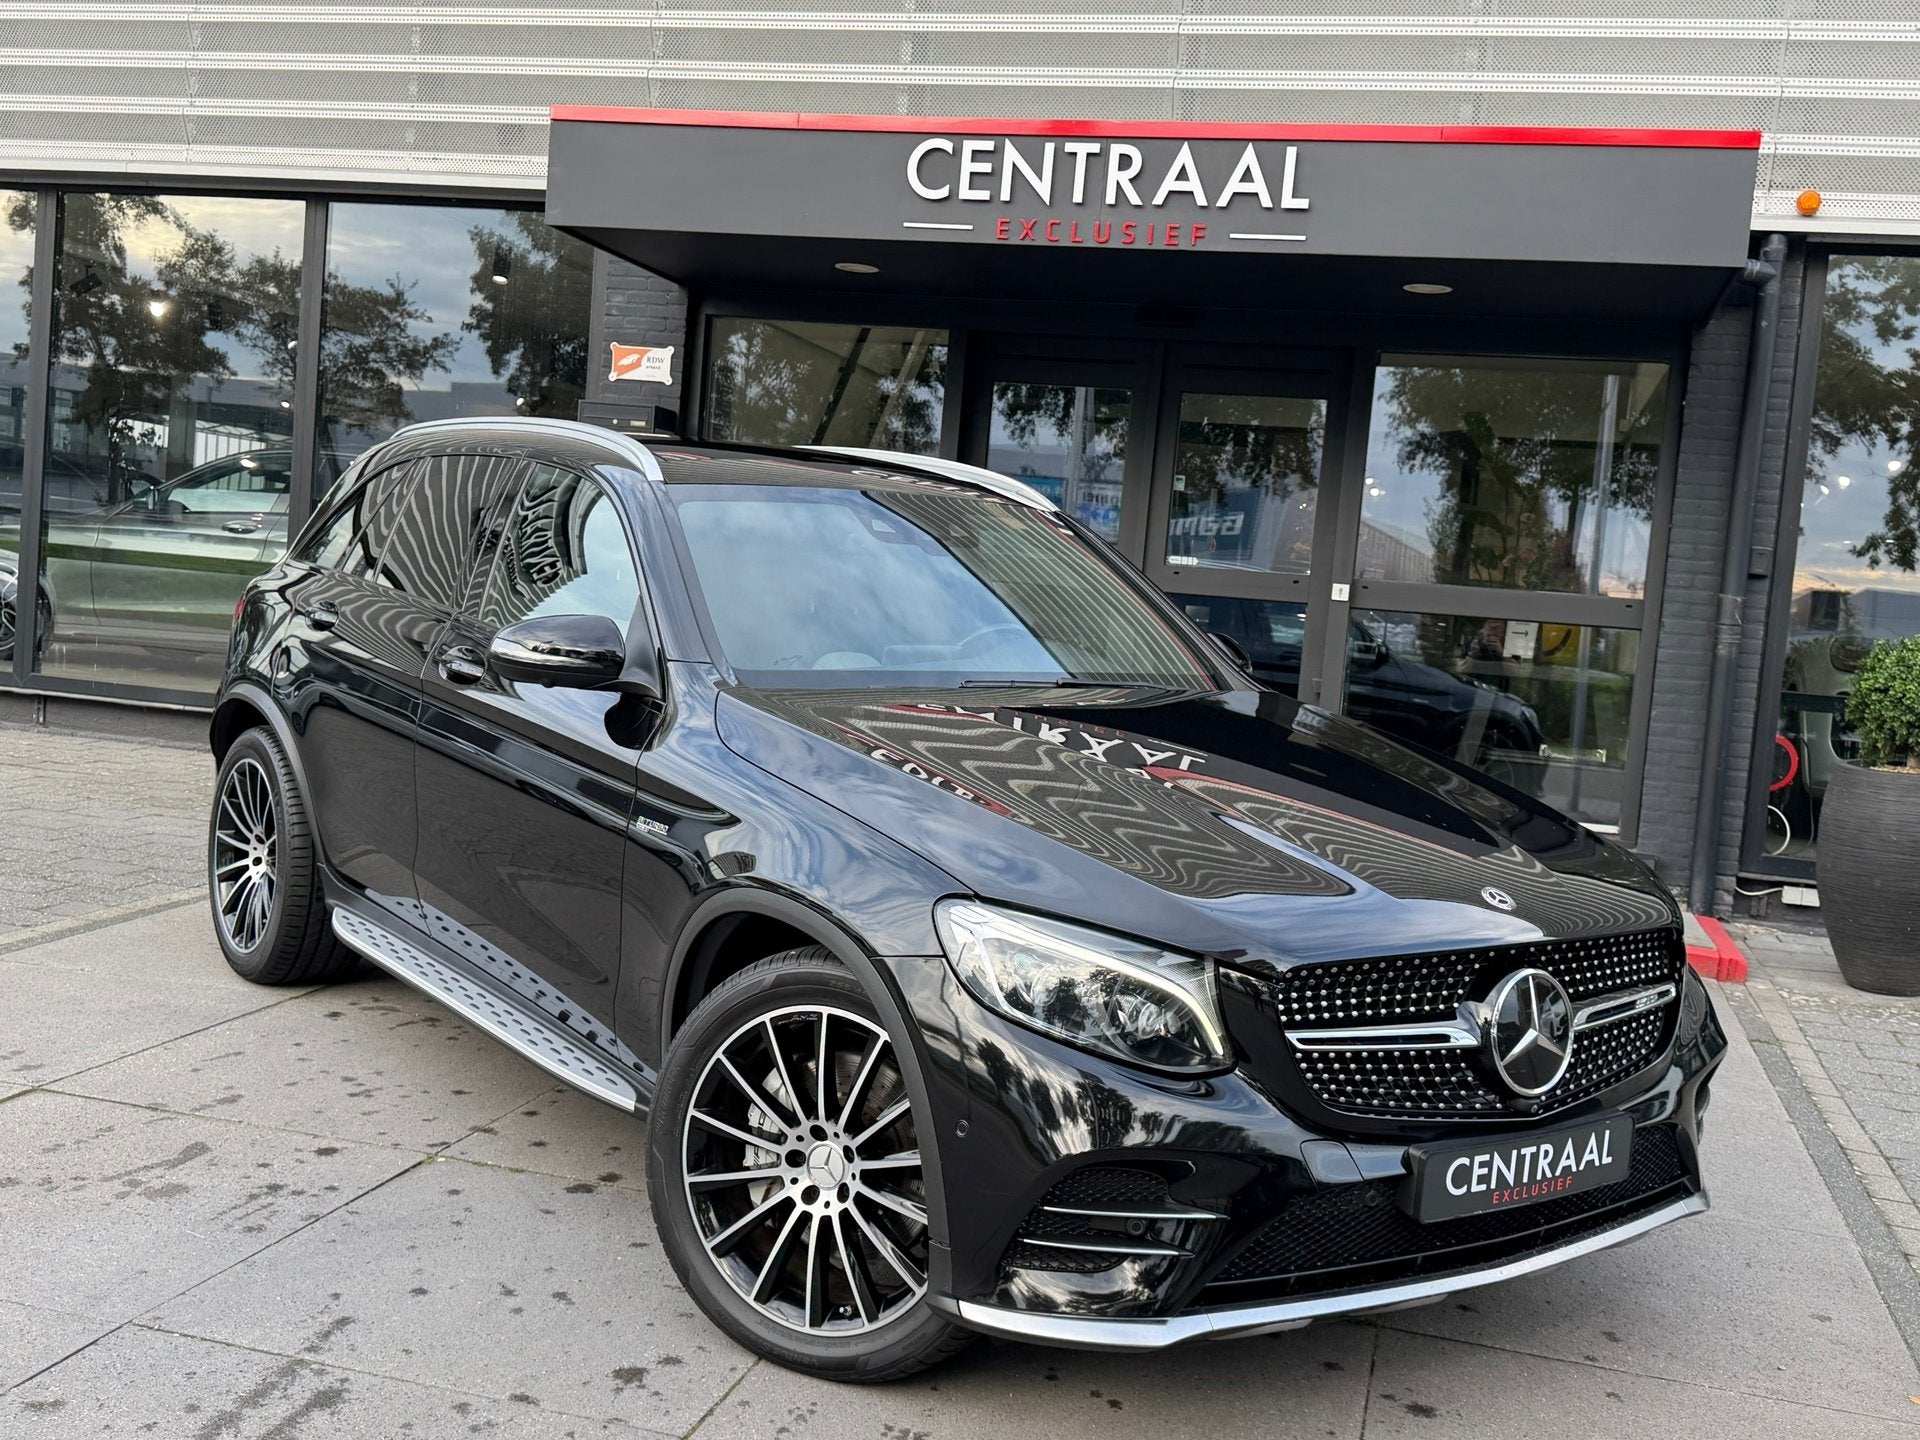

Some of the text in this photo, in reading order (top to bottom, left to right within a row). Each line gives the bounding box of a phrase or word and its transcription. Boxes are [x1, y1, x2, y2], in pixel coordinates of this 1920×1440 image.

[906, 138, 1310, 209] CENTRAAL
[995, 217, 1208, 246] EXCLUSIEF
[646, 356, 666, 364] RDW
[1445, 1130, 1613, 1196] CENTRAAL
[1492, 1176, 1573, 1204] EXCLUSIEF
